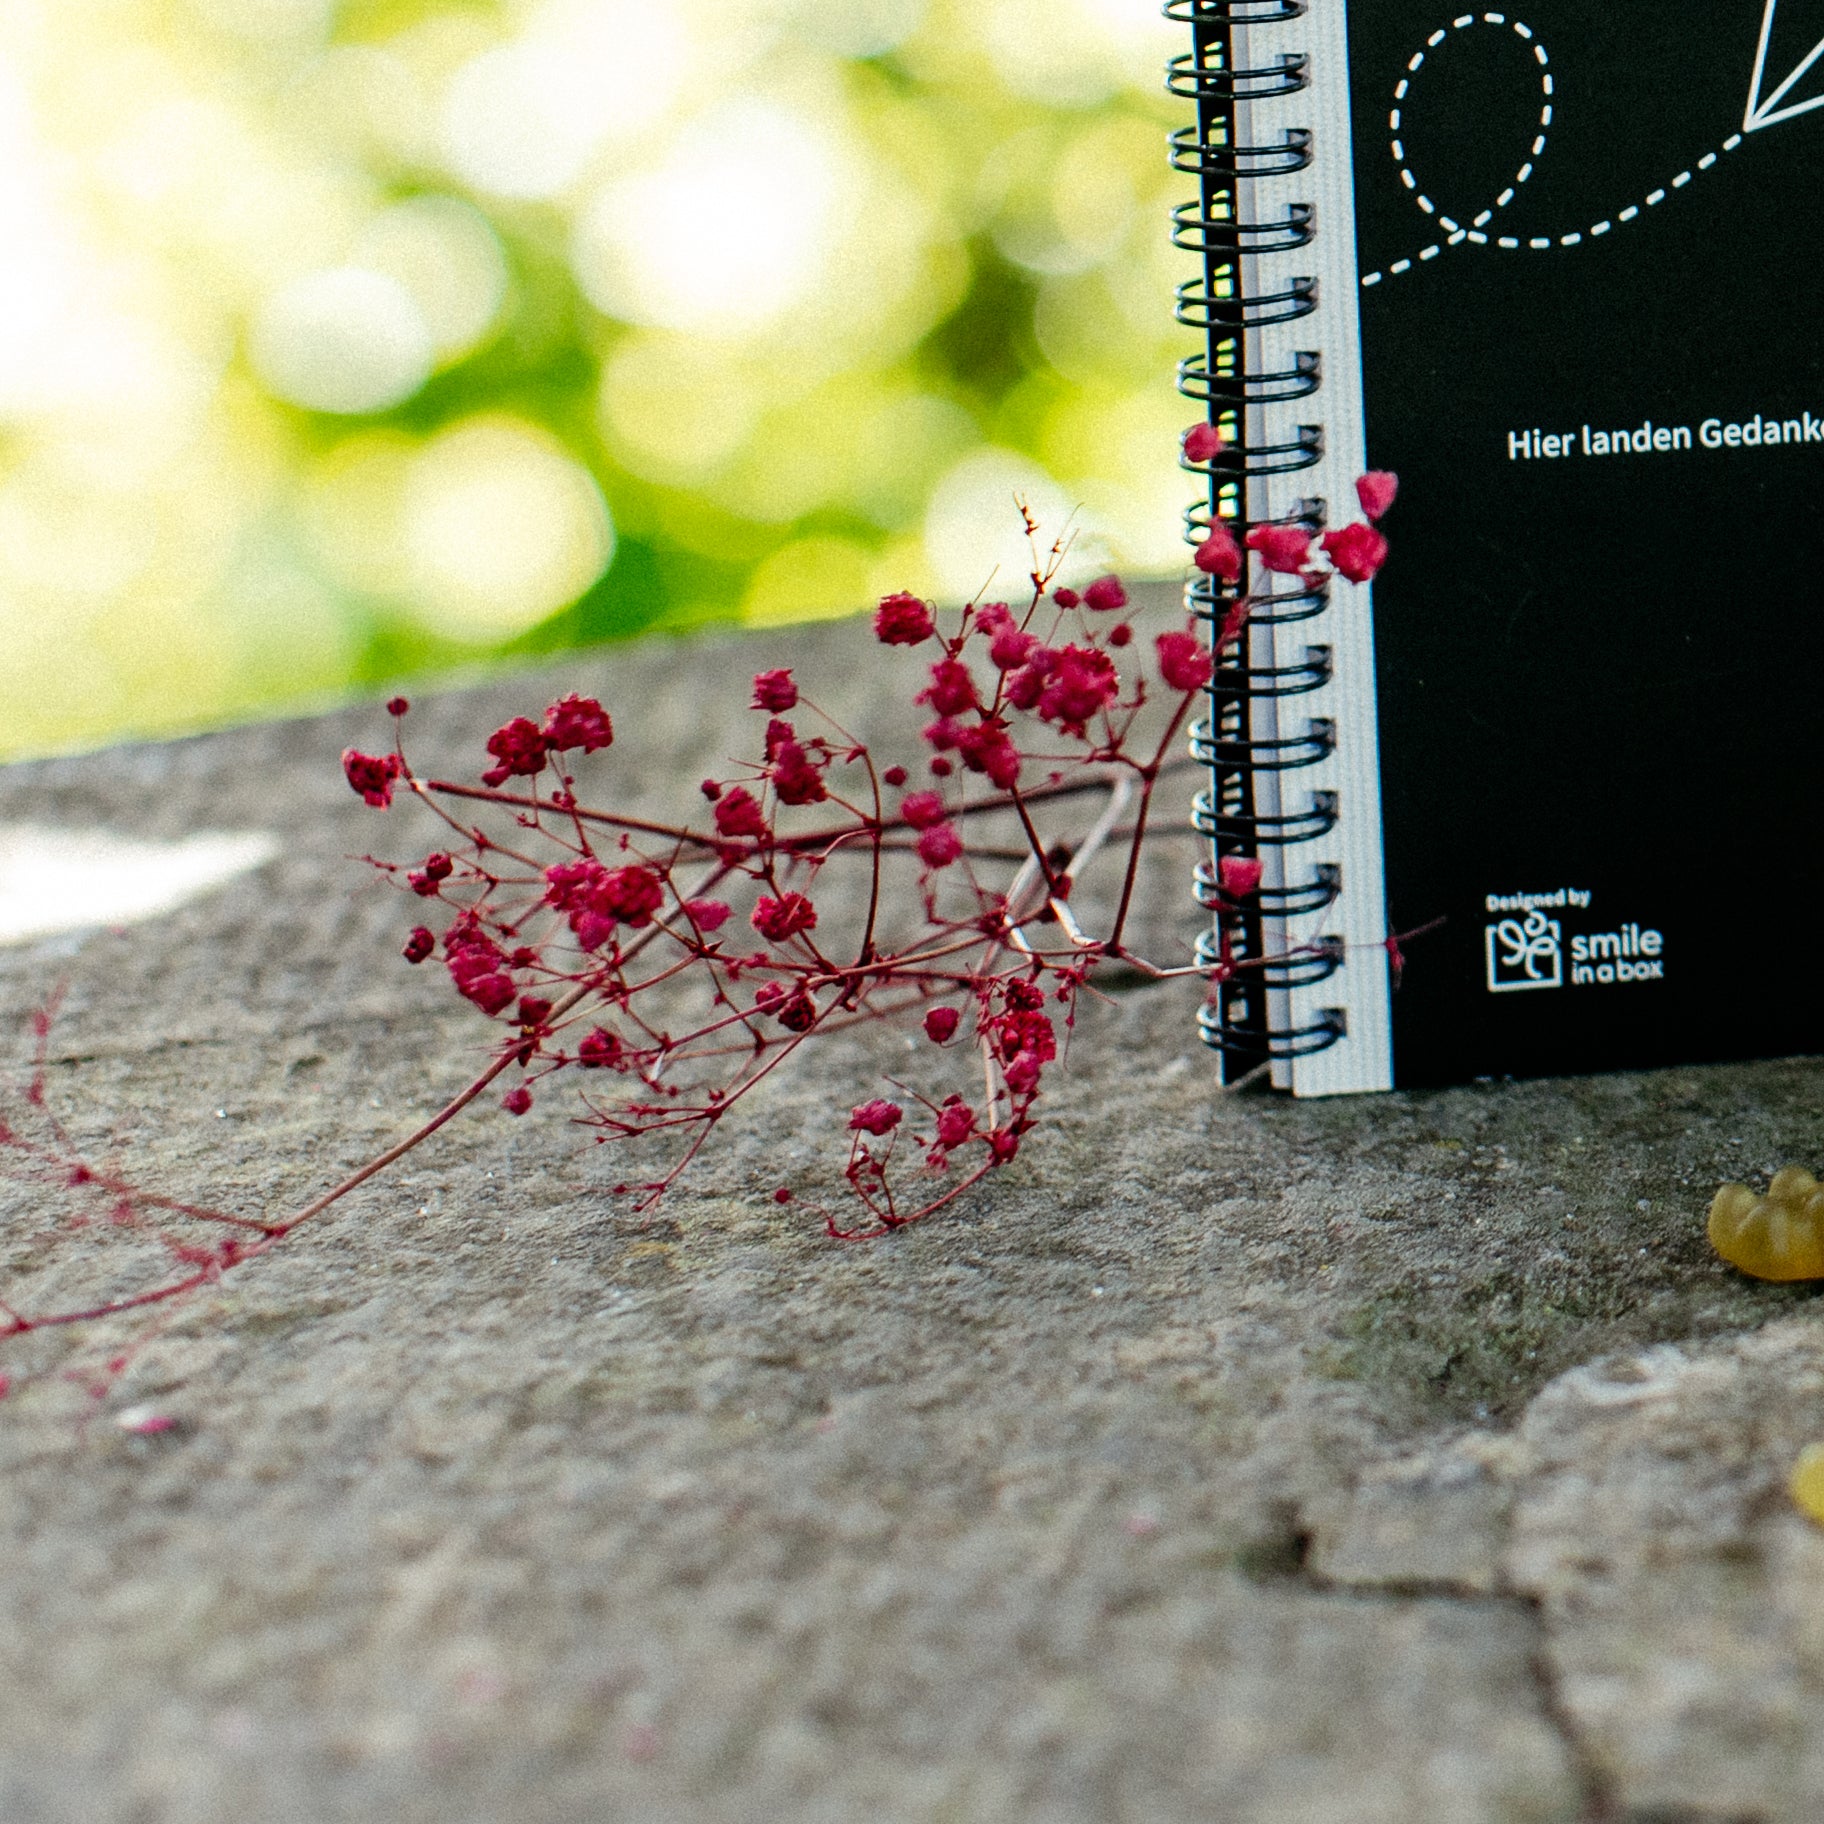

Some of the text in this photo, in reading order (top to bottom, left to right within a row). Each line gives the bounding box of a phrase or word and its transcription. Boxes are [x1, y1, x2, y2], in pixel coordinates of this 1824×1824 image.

[1507, 428, 1576, 461] Hier
[1582, 420, 1692, 456] landen
[1568, 886, 1592, 909] by
[1570, 921, 1664, 962] smile
